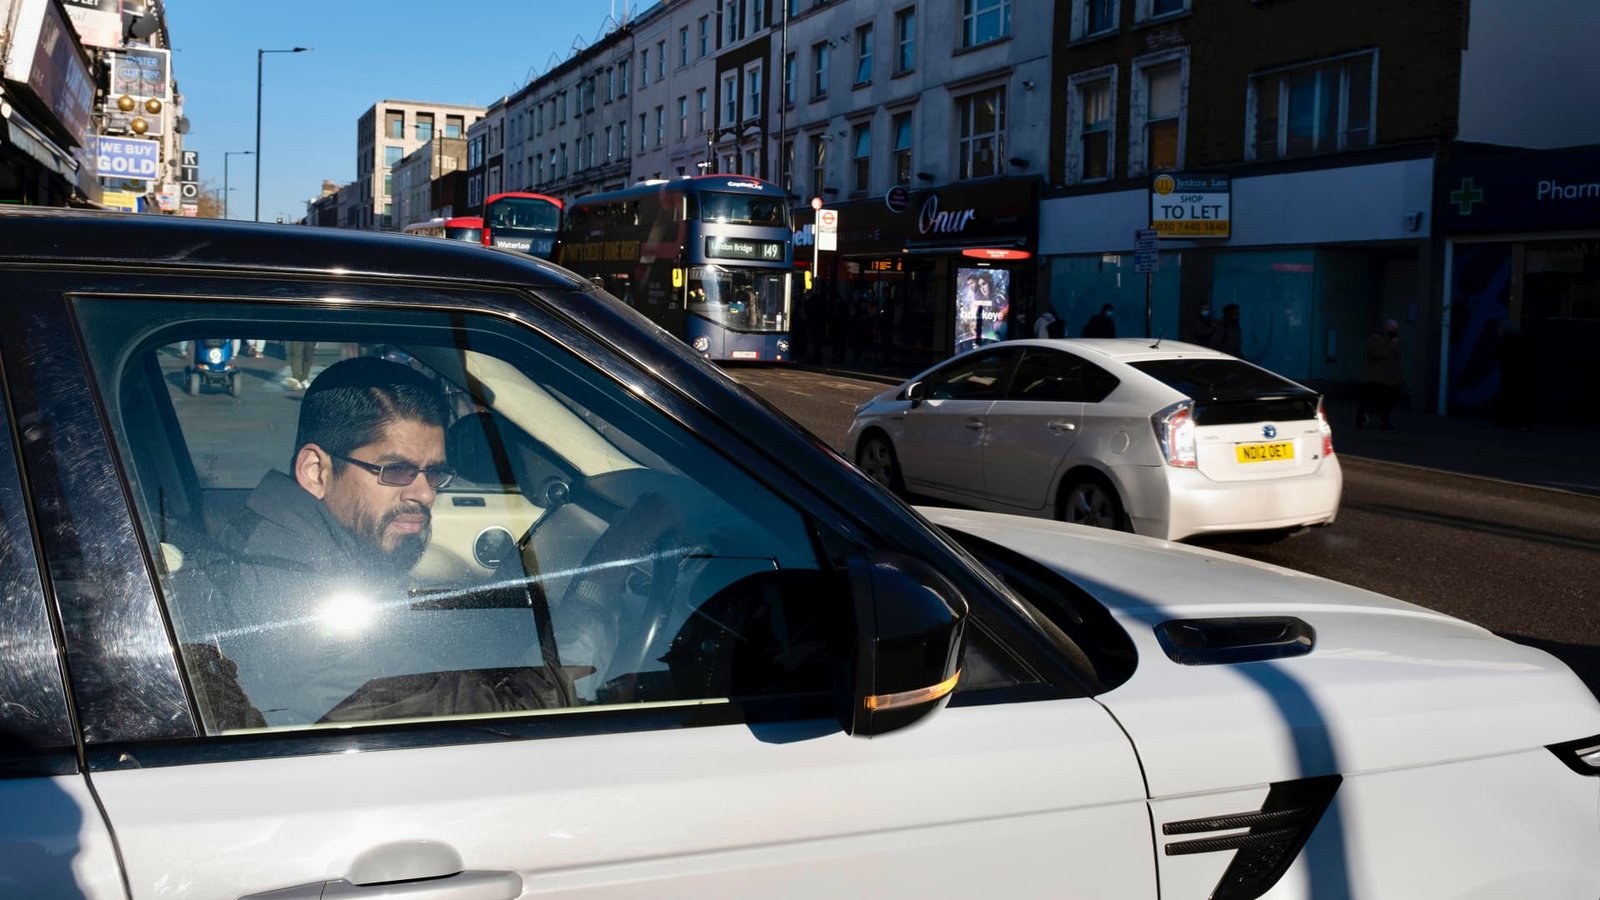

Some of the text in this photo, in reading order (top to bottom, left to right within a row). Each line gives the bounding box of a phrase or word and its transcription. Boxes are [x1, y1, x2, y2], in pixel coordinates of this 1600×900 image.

[101, 141, 153, 156] WE BUY
[98, 155, 155, 174] GOLD
[183, 151, 197, 197] RIO
[1180, 194, 1203, 203] SHOP
[918, 194, 975, 234] Onur
[1160, 205, 1222, 219] TO LET
[497, 240, 530, 250] Waterloo
[711, 242, 753, 254] London Bridge
[763, 244, 778, 257] 149
[1243, 444, 1287, 459] ND12 OET
